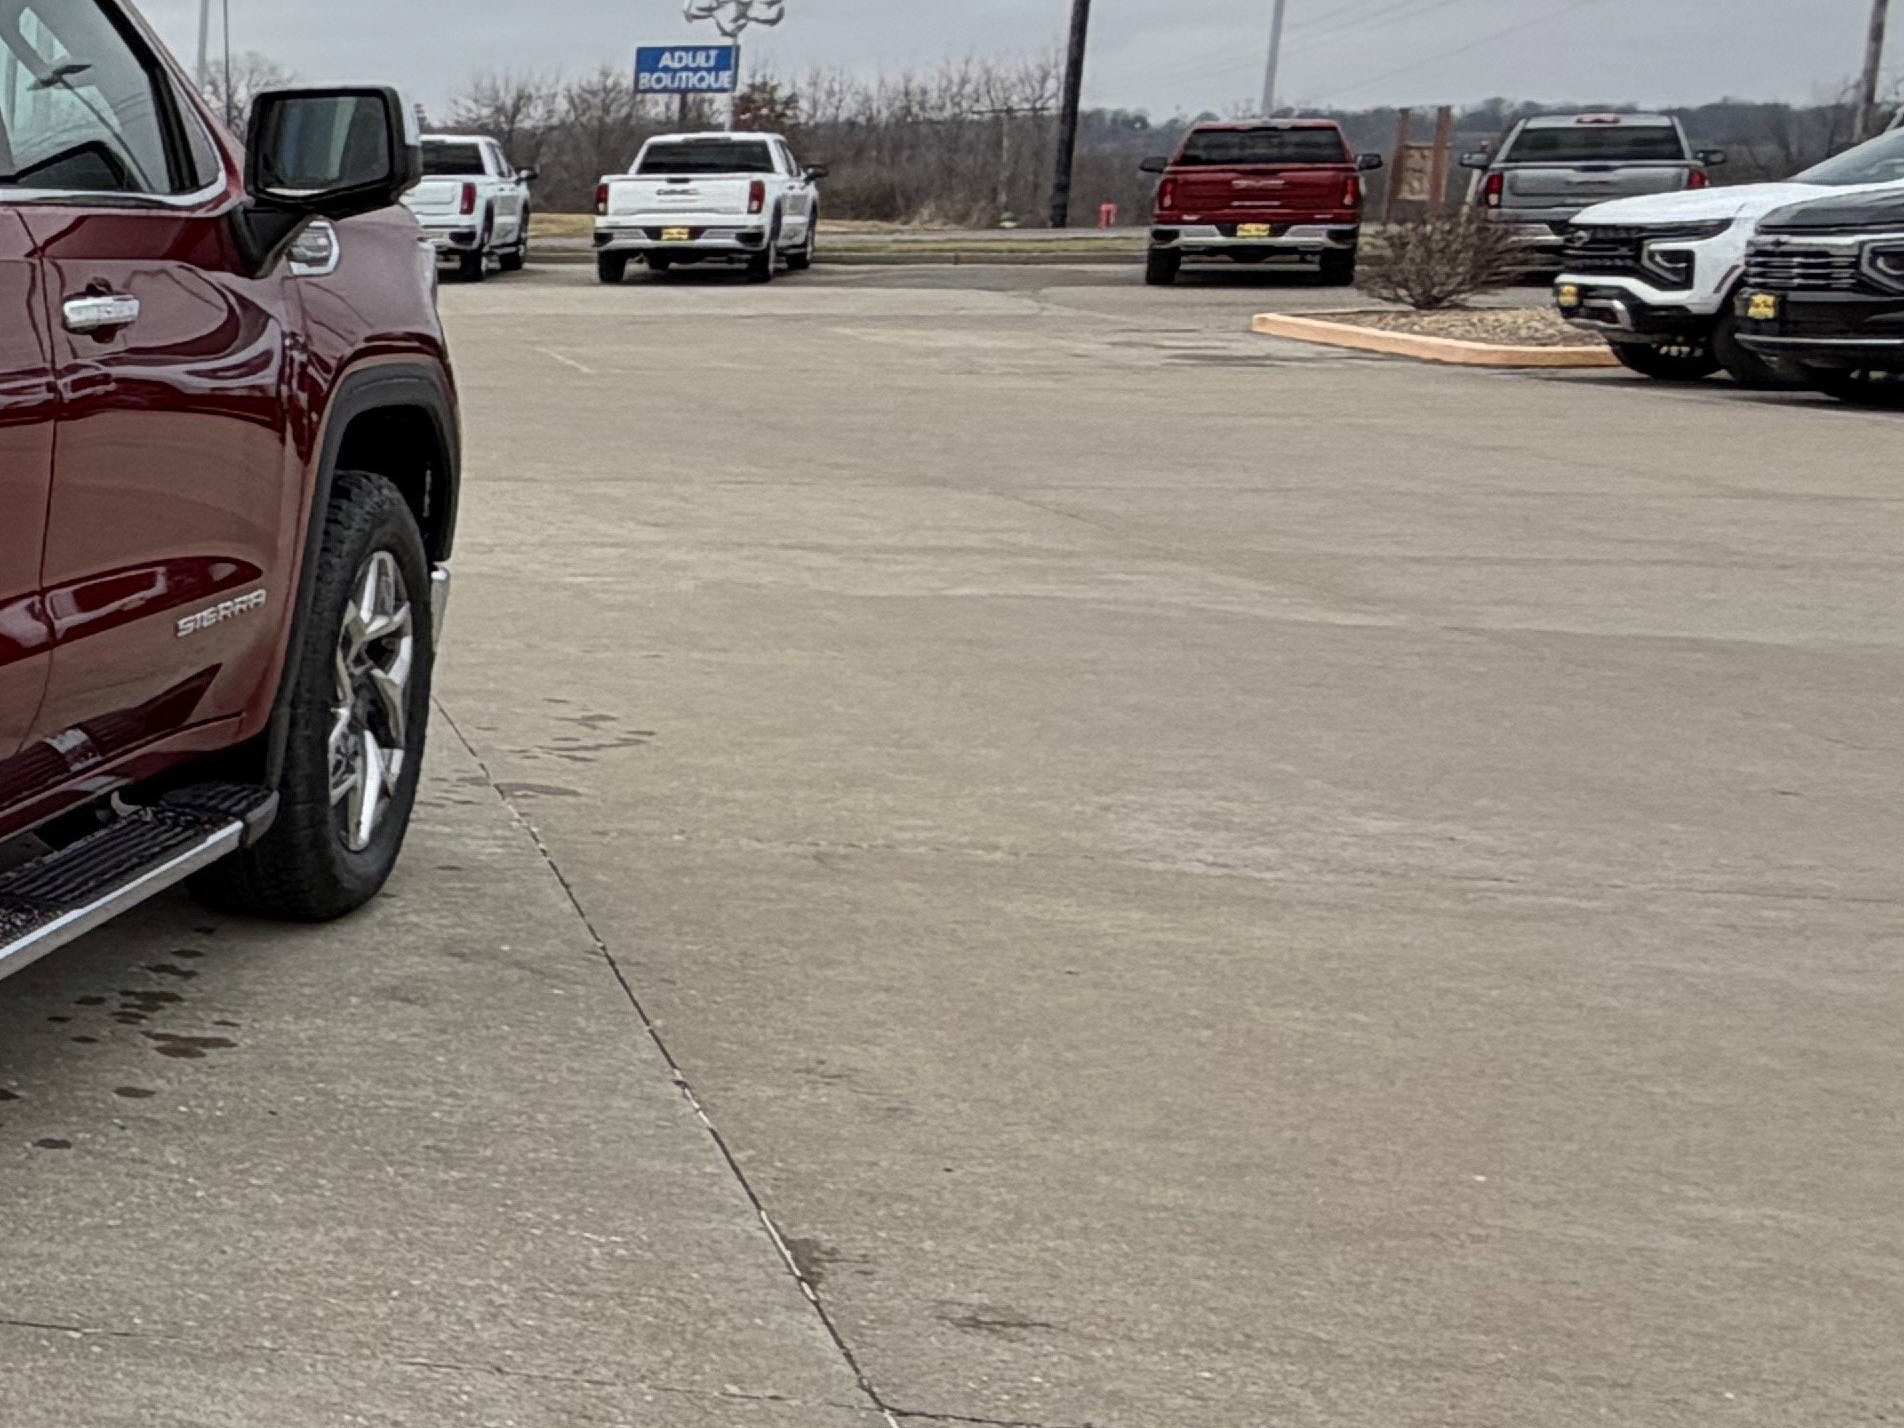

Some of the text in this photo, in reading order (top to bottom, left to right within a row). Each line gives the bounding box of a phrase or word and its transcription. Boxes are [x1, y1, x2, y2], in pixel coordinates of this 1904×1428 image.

[658, 49, 719, 69] ADULT
[638, 71, 733, 90] BOUTIQUE
[176, 588, 266, 638] SIERRA
